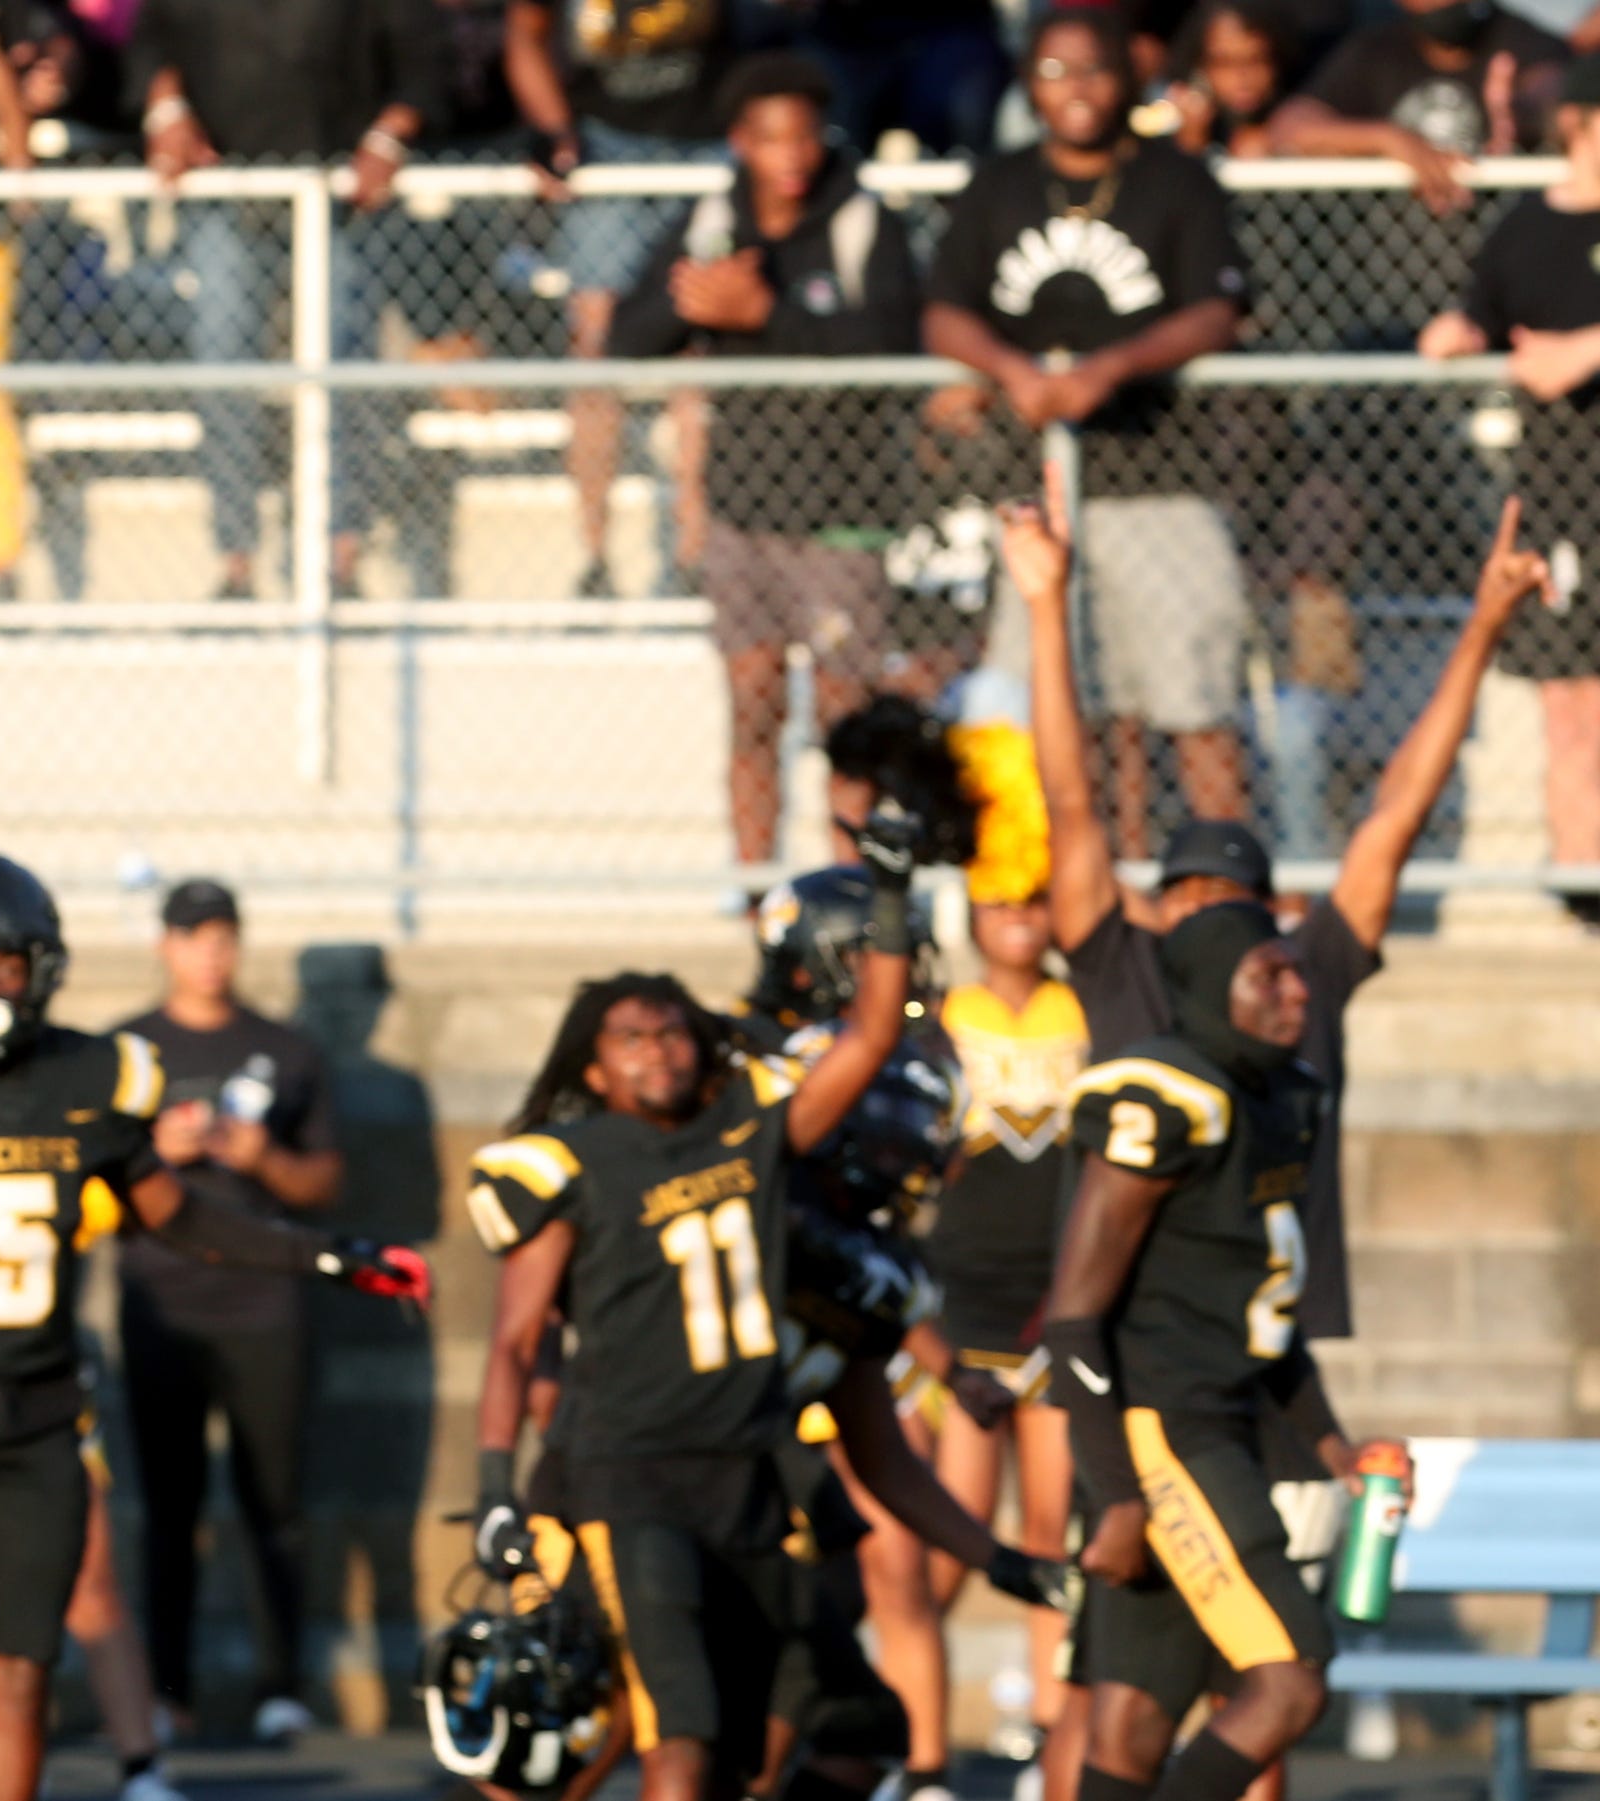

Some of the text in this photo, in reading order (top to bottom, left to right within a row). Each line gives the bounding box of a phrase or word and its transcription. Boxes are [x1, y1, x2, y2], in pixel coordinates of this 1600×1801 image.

[1104, 1099, 1158, 1169] 2
[658, 1196, 779, 1375] 11
[1245, 1200, 1309, 1361] 2
